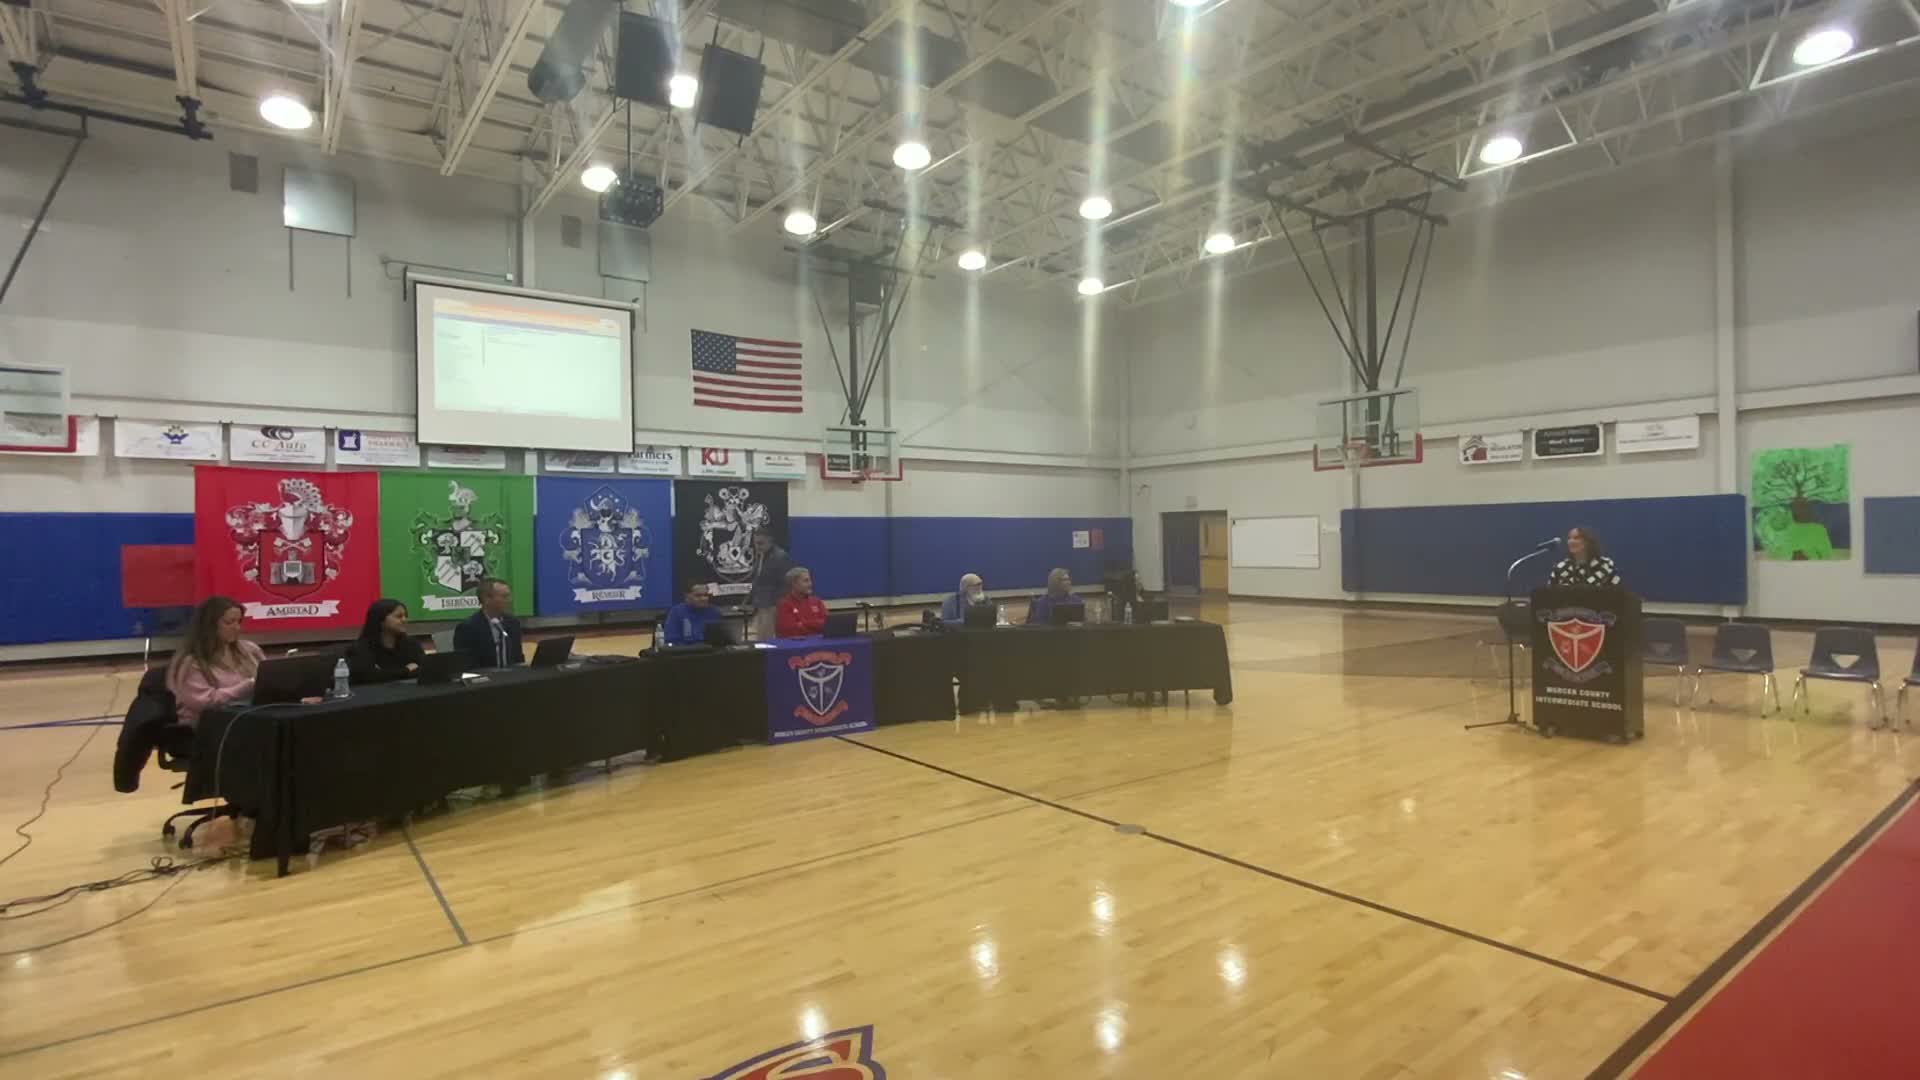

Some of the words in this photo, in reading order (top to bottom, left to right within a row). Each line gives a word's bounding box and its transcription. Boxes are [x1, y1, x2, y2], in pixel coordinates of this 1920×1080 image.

[277, 440, 307, 449] Auto
[701, 447, 729, 466] KU
[266, 605, 319, 617] AMISTAD
[1580, 690, 1610, 698] COUNTY
[1591, 701, 1622, 711] SCHOOL
